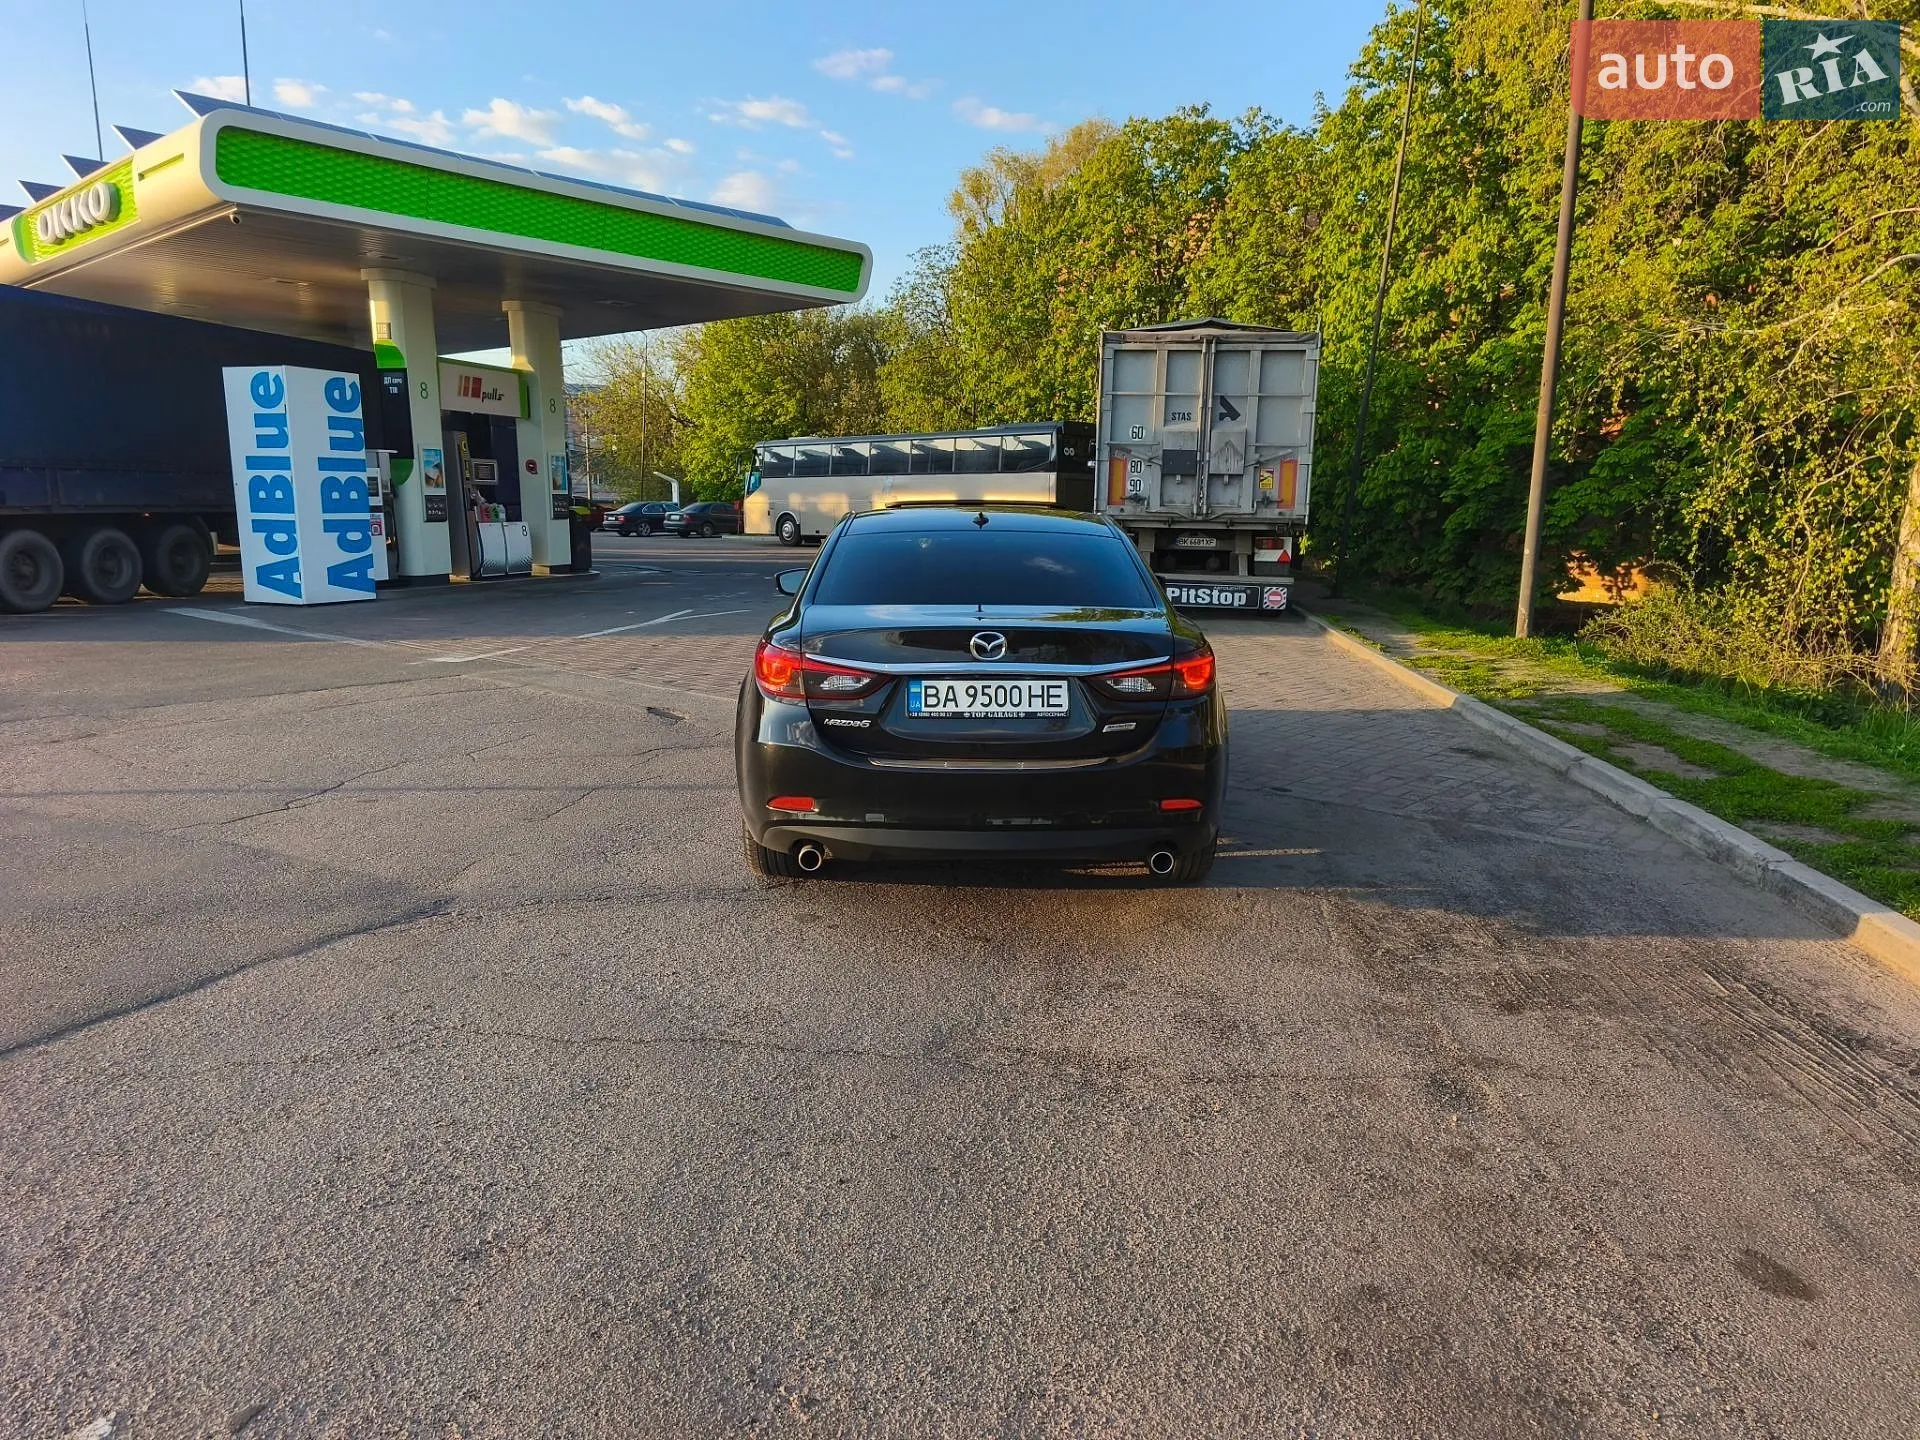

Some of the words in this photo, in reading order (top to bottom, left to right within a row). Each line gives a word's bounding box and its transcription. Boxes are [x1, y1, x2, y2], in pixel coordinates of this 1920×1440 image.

[37, 182, 115, 244] OKKO
[420, 382, 428, 399] 8
[481, 387, 504, 402] pulls
[549, 398, 556, 413] 8
[1171, 411, 1192, 421] STAS
[1131, 426, 1144, 439] 60
[1130, 460, 1142, 473] 80
[245, 371, 303, 599] AdBlue
[317, 376, 377, 595] AdBlue
[1129, 479, 1141, 491] 90
[521, 525, 528, 536] 8
[1166, 587, 1247, 607] PitStop
[923, 685, 959, 708] BA
[965, 685, 1022, 708] 9500
[1028, 685, 1063, 708] HE
